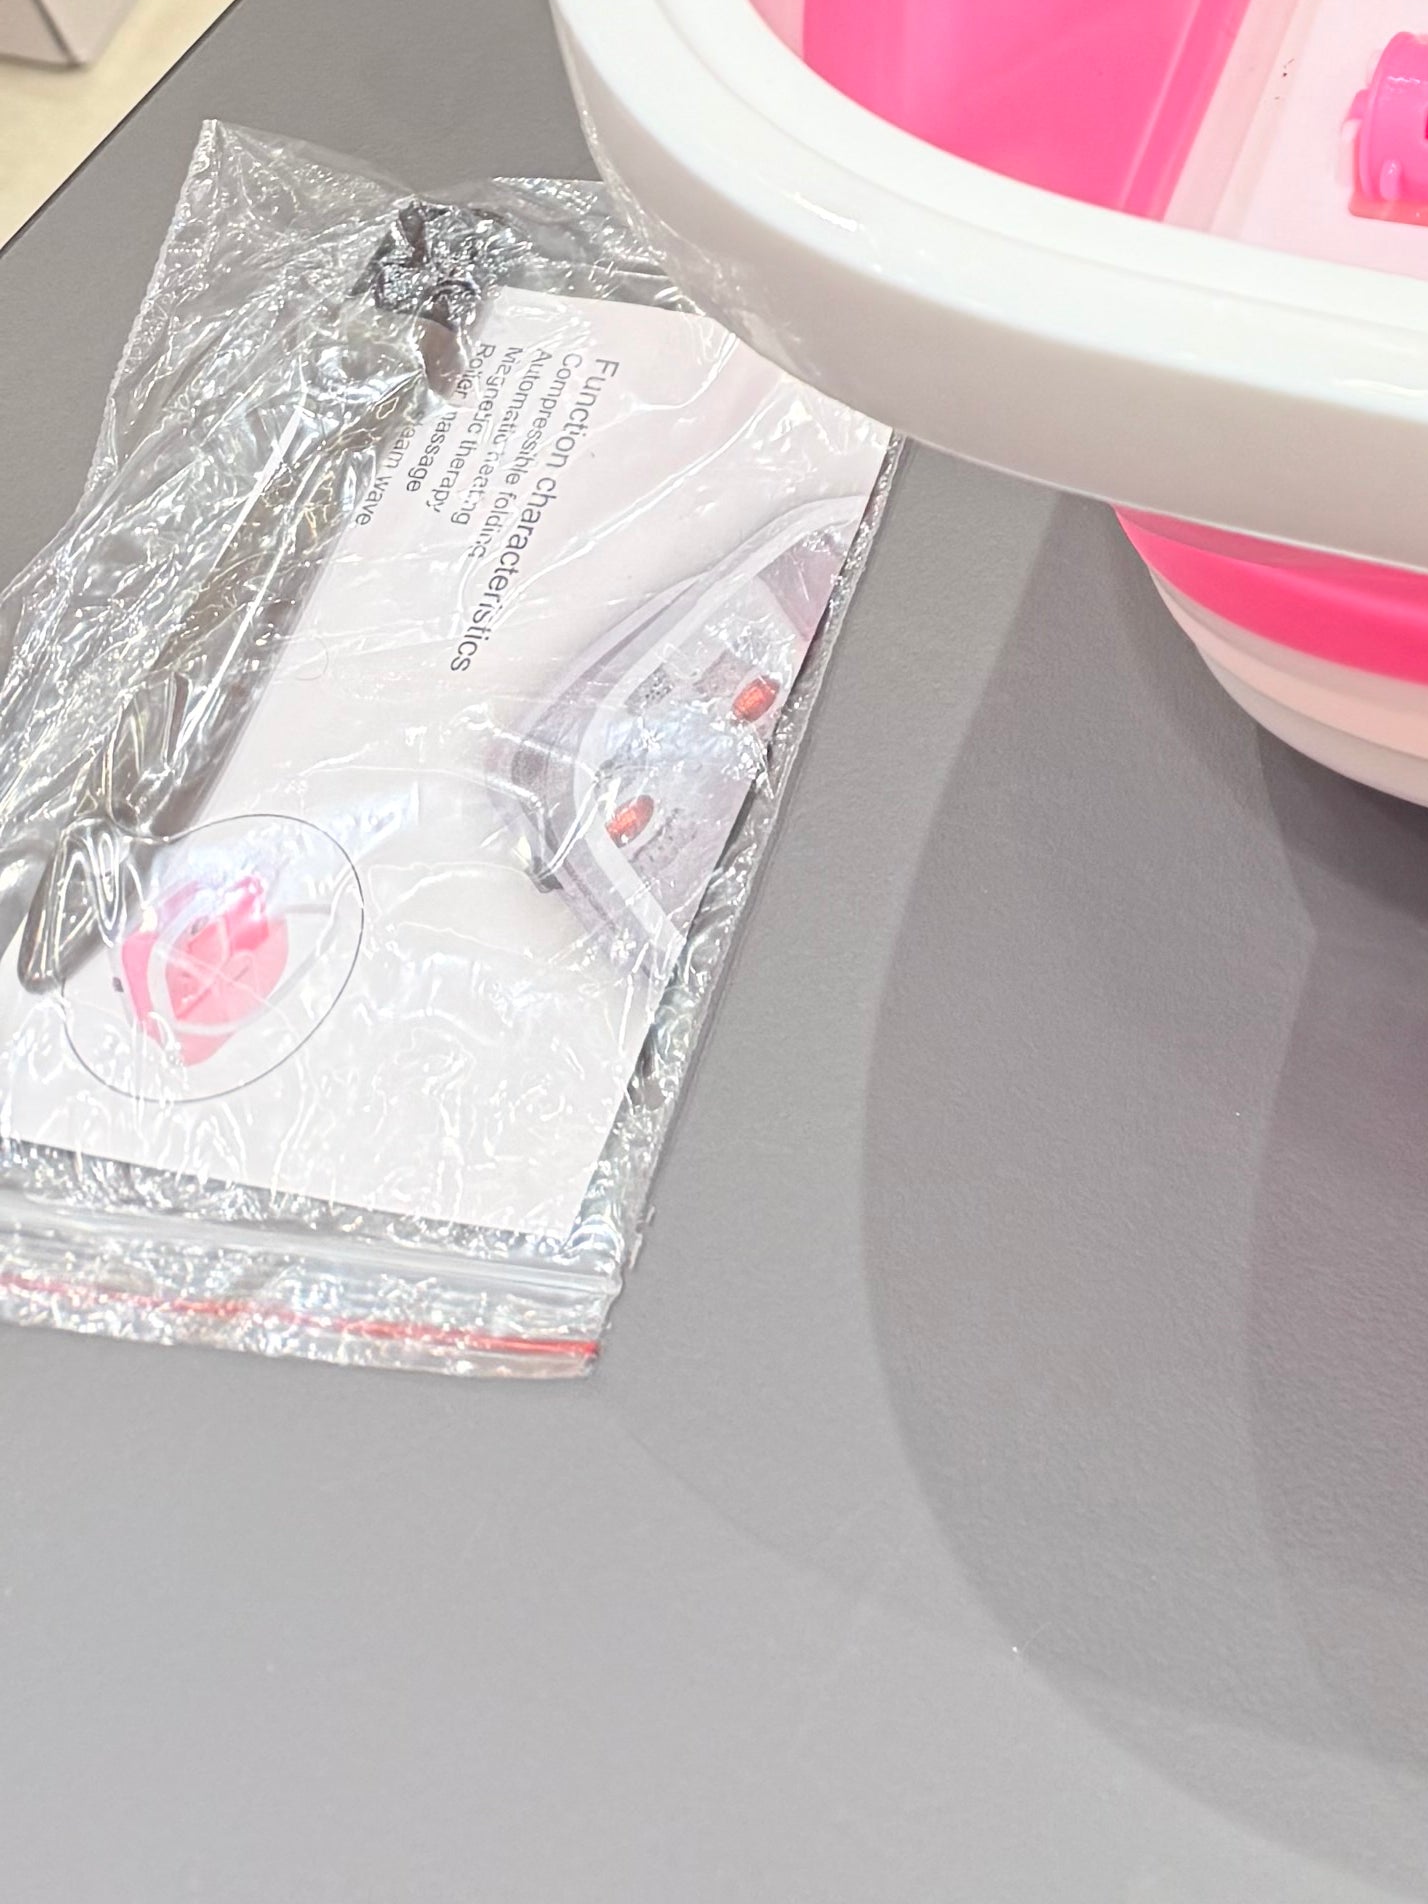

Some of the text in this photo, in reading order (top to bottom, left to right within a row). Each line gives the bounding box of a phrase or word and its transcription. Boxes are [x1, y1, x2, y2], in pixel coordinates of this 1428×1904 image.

[493, 347, 552, 445] Automatic
[505, 353, 583, 486] Compressible
[355, 473, 392, 527] wave
[427, 439, 479, 514] therapy
[450, 357, 619, 673] Function characteristics
